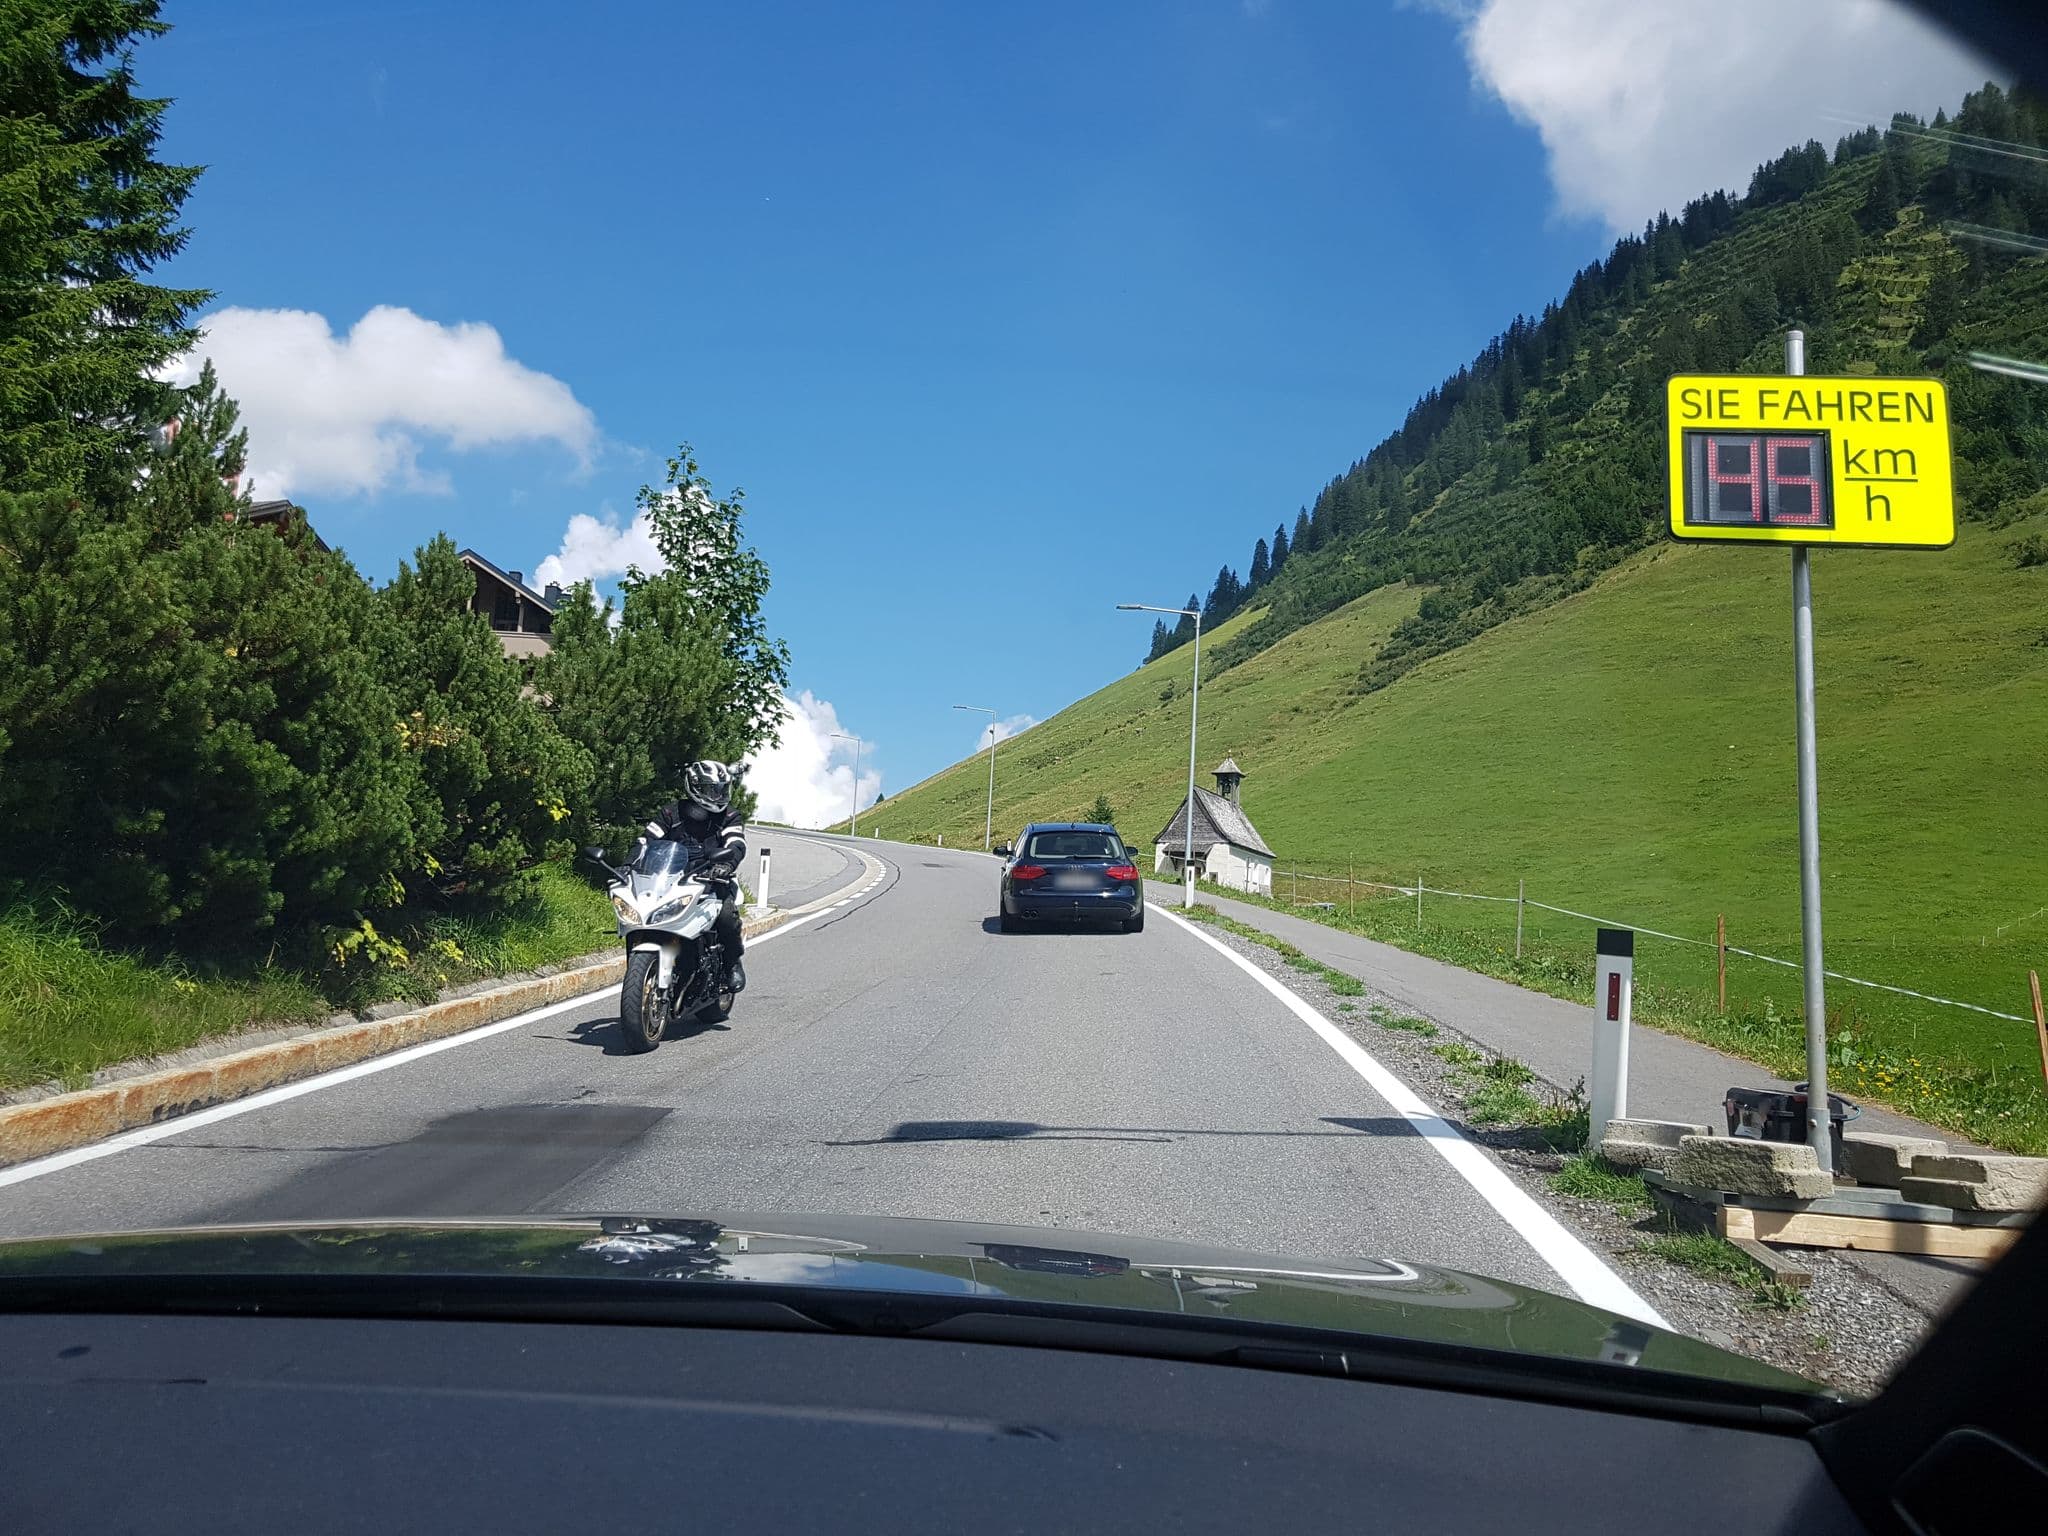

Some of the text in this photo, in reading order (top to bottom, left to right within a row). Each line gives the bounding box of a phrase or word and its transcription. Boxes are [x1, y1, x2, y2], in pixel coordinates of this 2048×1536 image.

[1681, 388, 1934, 423] SIE FAHREN
[1843, 439, 1917, 475] km
[1707, 437, 1821, 523] 45
[1865, 485, 1891, 521] h
